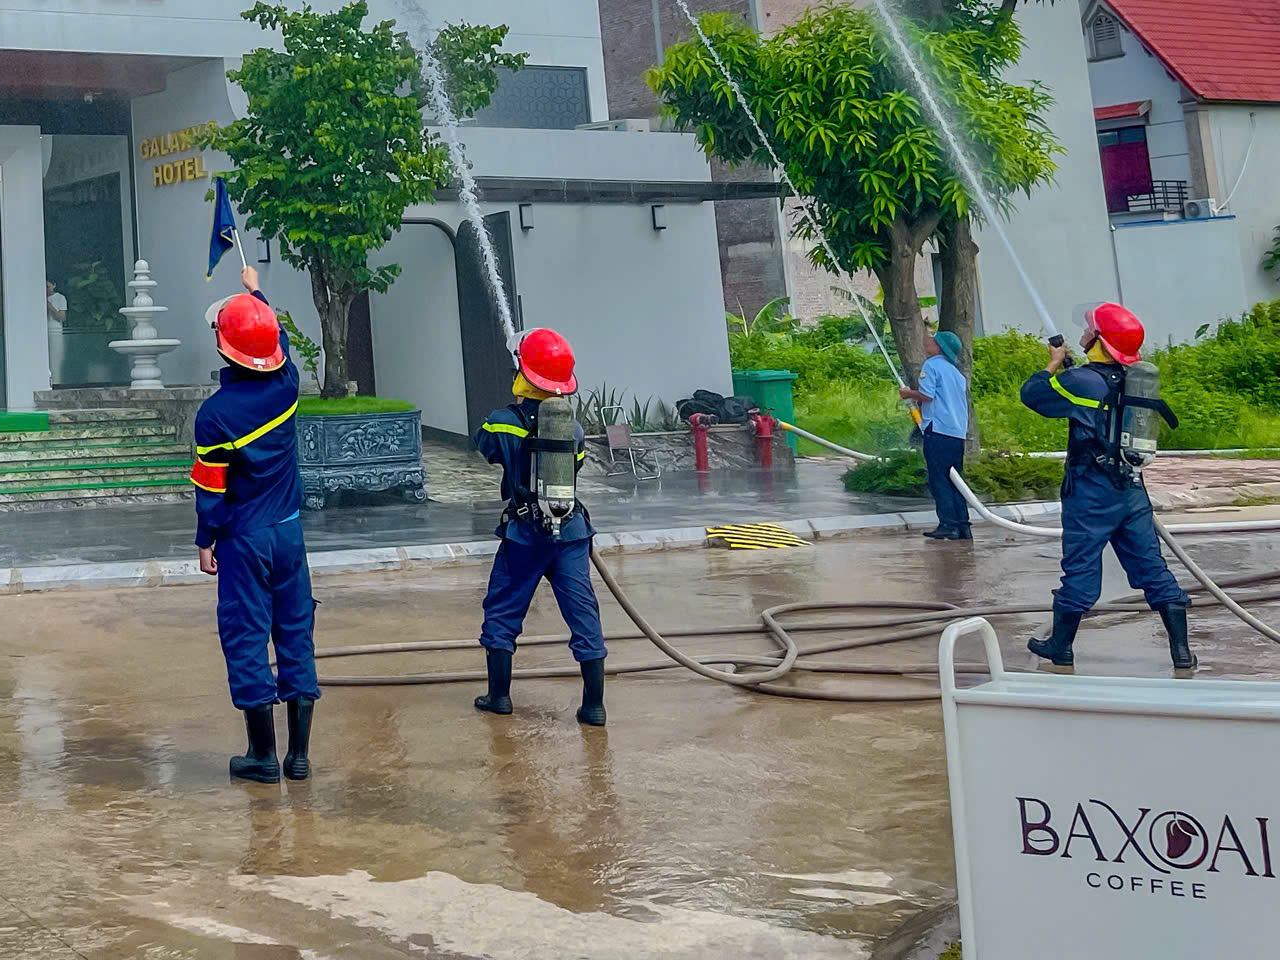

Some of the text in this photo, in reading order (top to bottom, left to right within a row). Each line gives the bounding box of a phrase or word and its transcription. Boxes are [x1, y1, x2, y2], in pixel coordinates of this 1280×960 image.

[152, 155, 208, 188] HOTEL
[1016, 796, 1277, 878] BAXOAI
[1086, 872, 1207, 900] COFFEE
